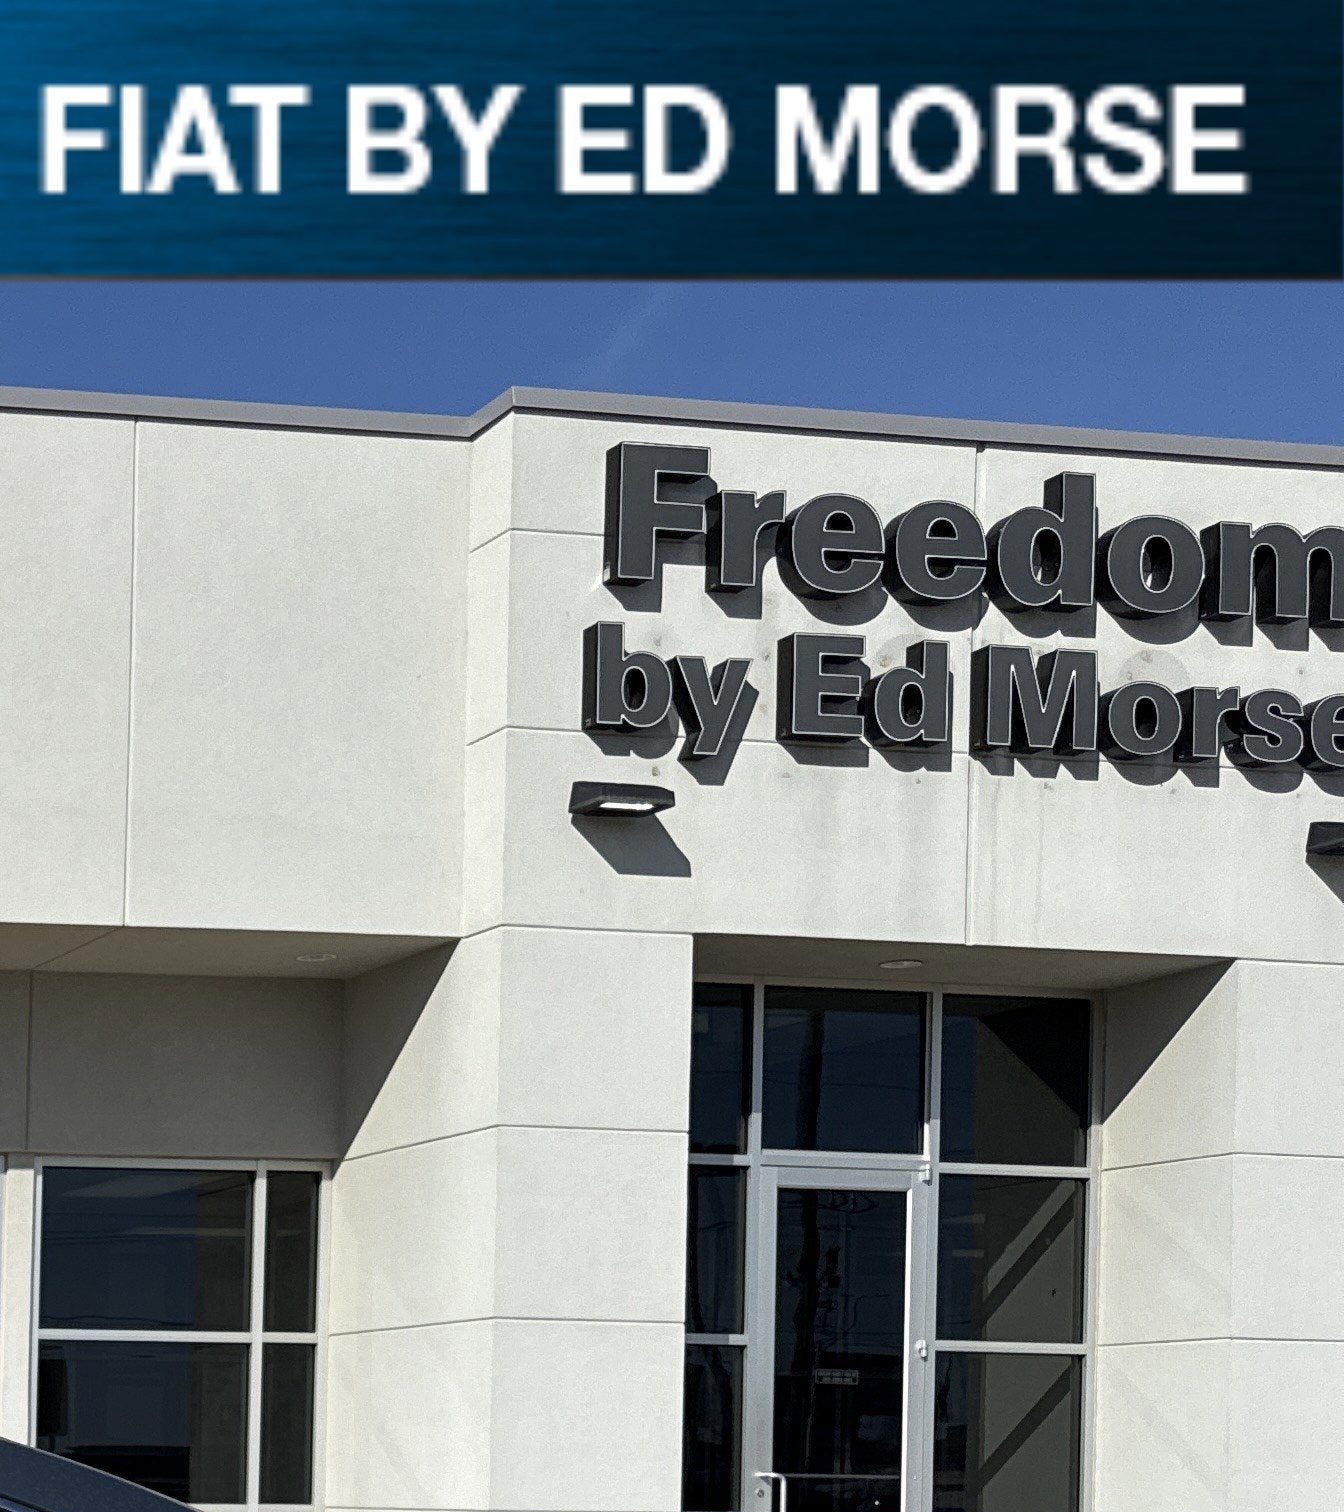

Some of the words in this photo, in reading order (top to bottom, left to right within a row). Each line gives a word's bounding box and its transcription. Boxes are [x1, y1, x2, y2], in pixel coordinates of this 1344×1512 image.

[603, 441, 1344, 622] Freedom
[583, 621, 753, 757] by
[776, 632, 950, 743] Ed
